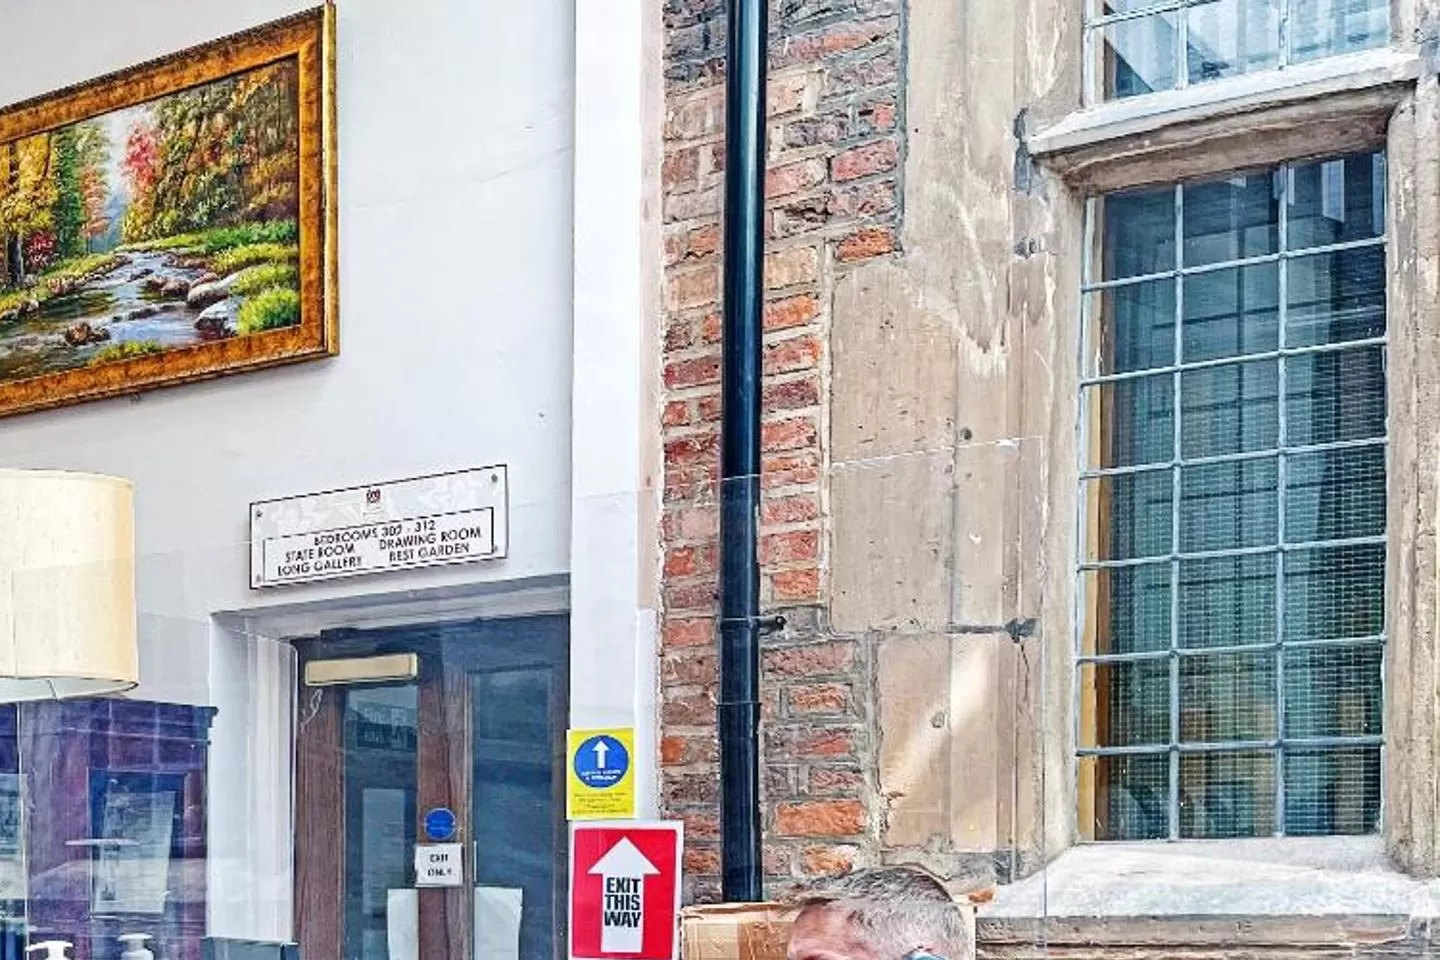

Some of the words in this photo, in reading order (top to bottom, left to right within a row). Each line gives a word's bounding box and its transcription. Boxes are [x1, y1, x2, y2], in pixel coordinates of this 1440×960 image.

[314, 527, 378, 546] BEDROOMS
[414, 519, 437, 533] 312
[379, 533, 437, 550] DRAWING
[441, 526, 482, 542] ROOM
[285, 548, 314, 563] STATE
[318, 543, 355, 557] ROOM
[418, 542, 470, 558] GARDEN
[277, 561, 310, 576] LONG
[314, 556, 362, 571] GALLERY
[429, 853, 449, 863] EXIT
[606, 877, 642, 894] EXIT
[604, 894, 641, 911] THIS
[604, 911, 643, 928] WAY
